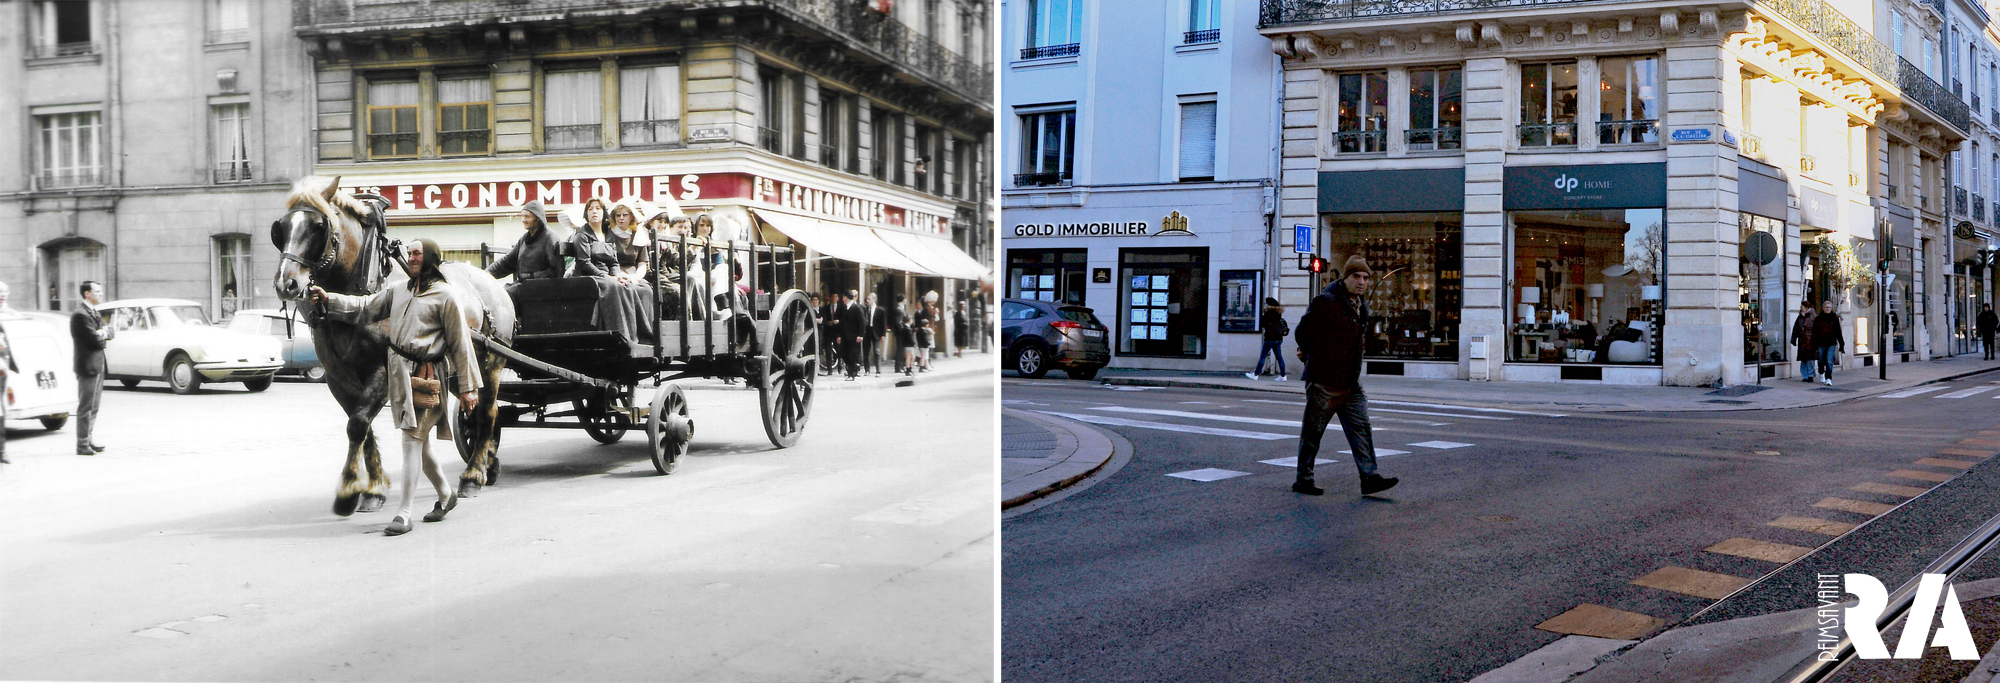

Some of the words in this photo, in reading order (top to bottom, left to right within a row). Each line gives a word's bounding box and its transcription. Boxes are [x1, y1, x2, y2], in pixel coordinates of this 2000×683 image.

[1554, 173, 1579, 193] dp
[1584, 180, 1613, 189] HOME
[1014, 224, 1054, 236] GOLD
[1058, 222, 1147, 236] IMMOBILIER
